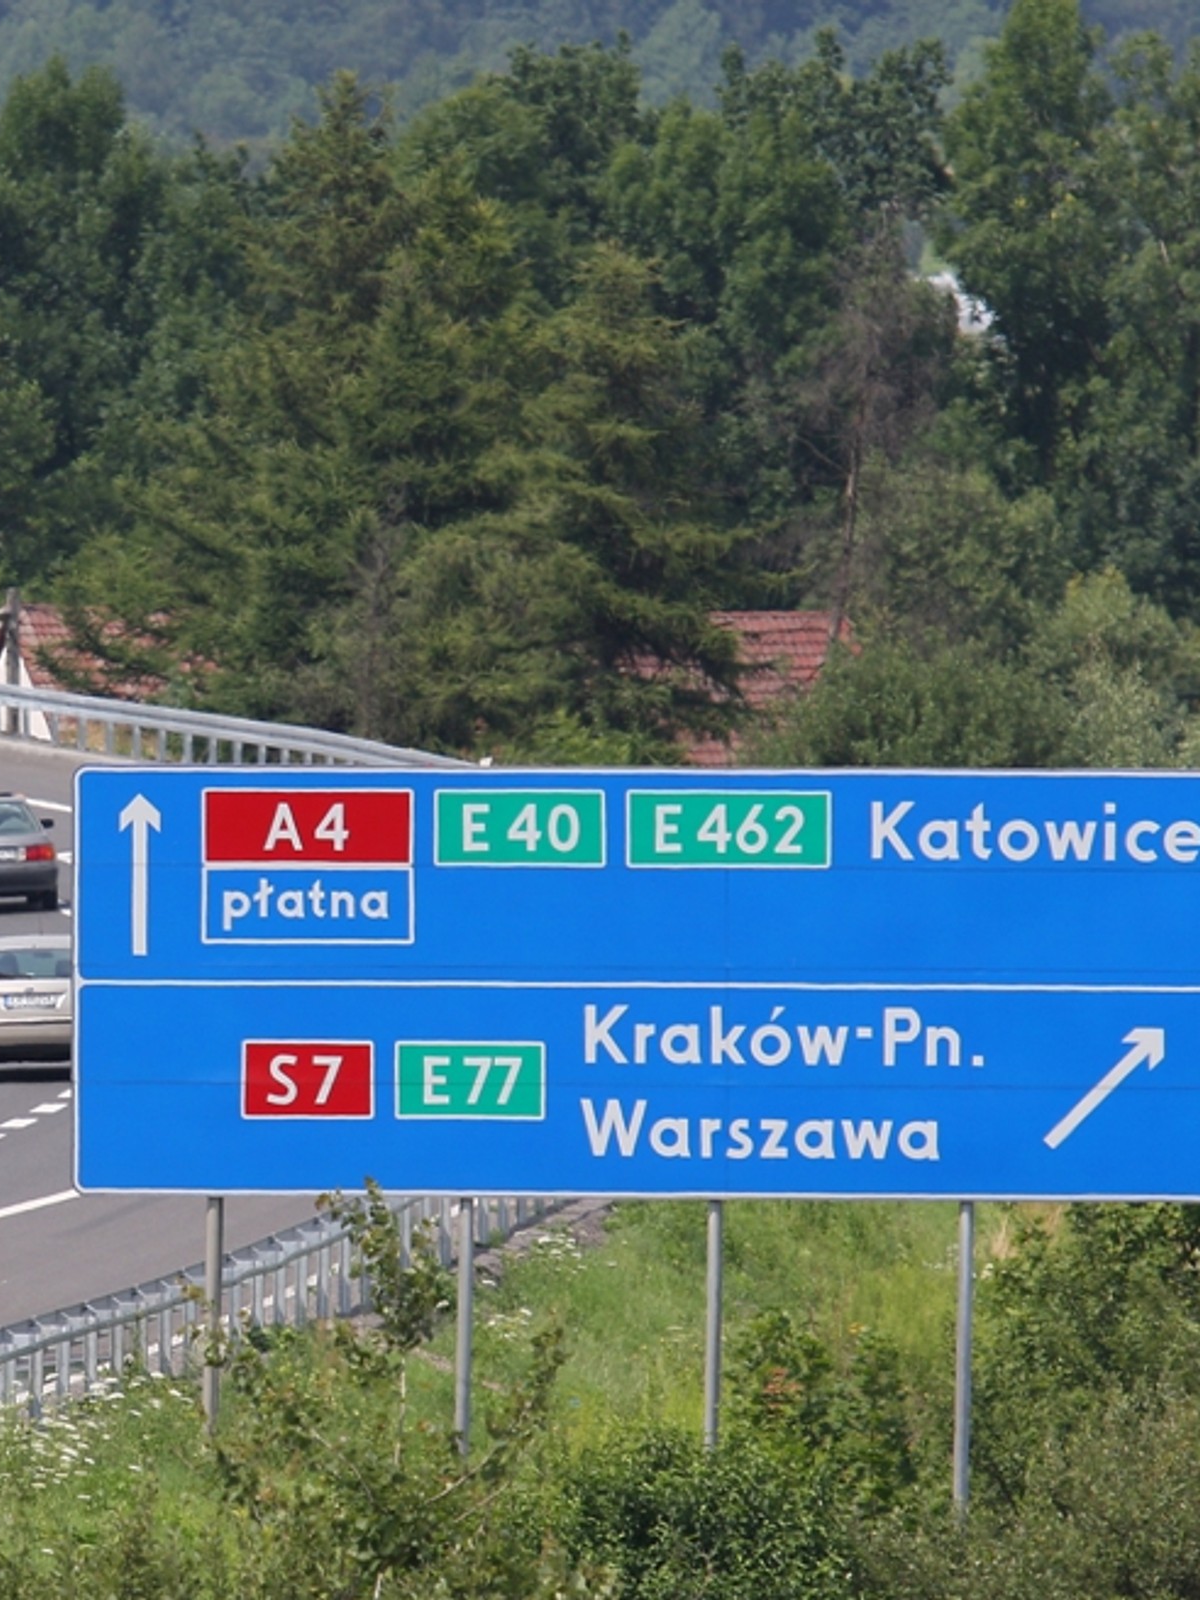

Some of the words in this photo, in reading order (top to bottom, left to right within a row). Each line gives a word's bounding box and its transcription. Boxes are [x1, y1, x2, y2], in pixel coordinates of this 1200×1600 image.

[462, 804, 490, 852] E
[507, 804, 580, 852] 40
[655, 804, 682, 853] E
[696, 804, 804, 853] 462
[871, 801, 1200, 862] Katowice
[223, 878, 389, 930] płatna
[583, 1004, 984, 1067] Kraków-Pn.
[267, 1054, 298, 1105] S
[313, 1055, 343, 1105] 7
[422, 1056, 451, 1105] E
[463, 1057, 523, 1105] 77
[580, 1098, 940, 1160] Warszawa
